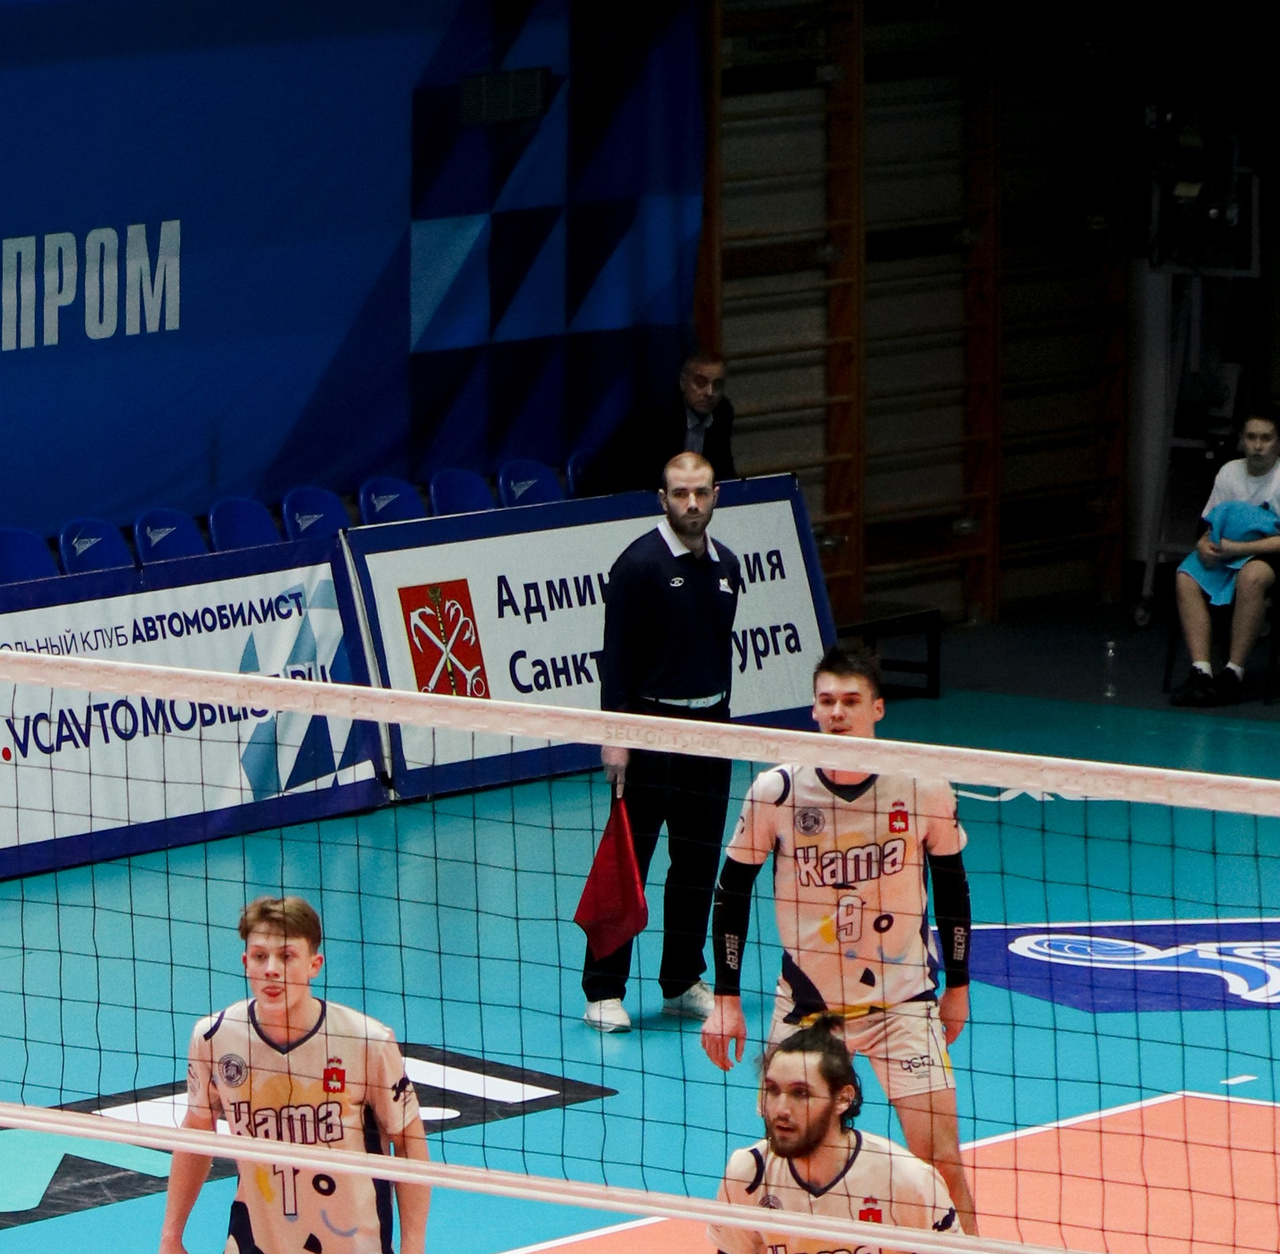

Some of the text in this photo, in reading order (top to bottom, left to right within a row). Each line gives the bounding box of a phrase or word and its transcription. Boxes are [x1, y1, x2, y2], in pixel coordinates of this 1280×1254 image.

[81, 625, 128, 651] КЛУБ
[131, 591, 306, 644] АВТОМОБИЛИСТ
[836, 894, 864, 944] 9
